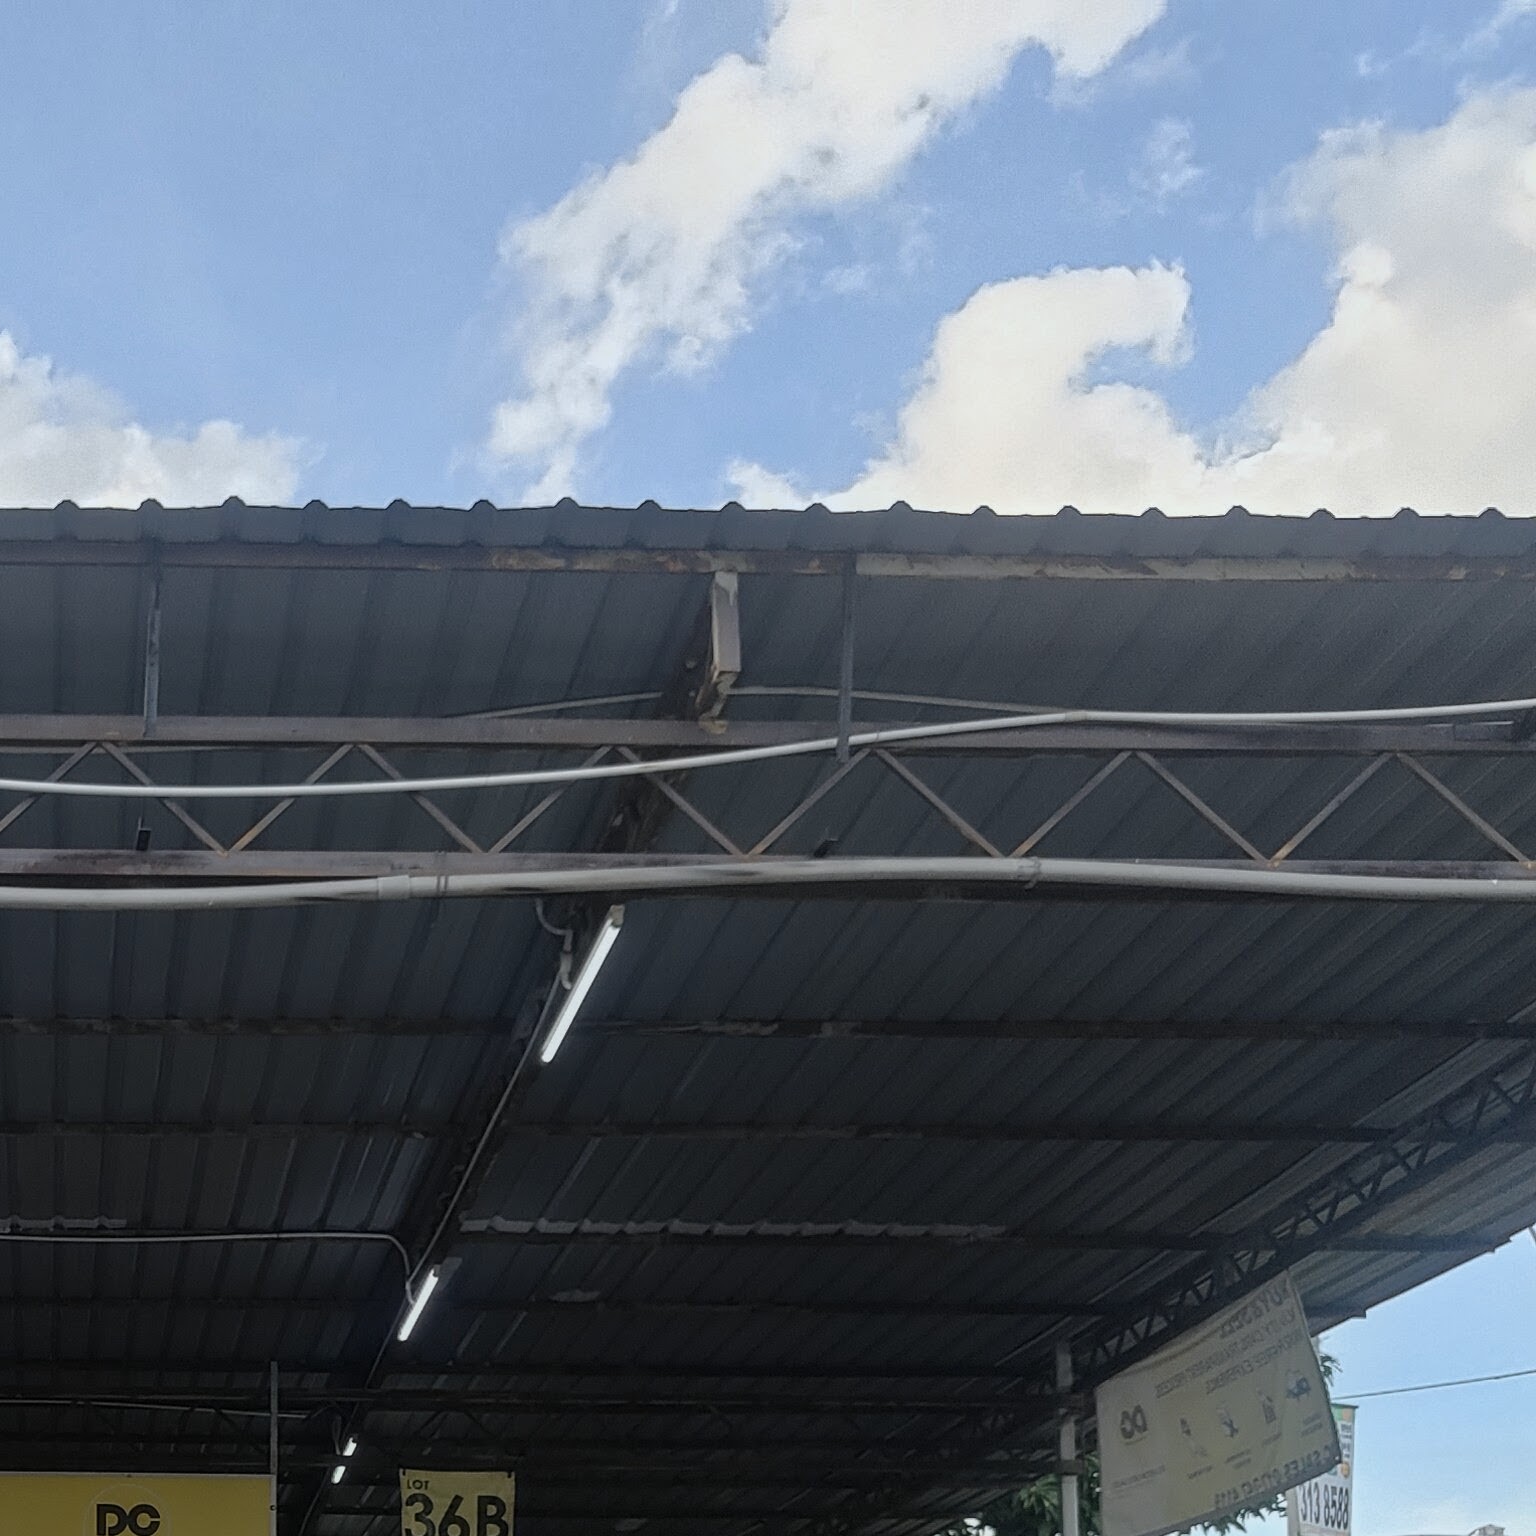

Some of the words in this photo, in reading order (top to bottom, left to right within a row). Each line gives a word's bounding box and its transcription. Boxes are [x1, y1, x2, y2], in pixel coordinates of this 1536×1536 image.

[407, 1479, 430, 1490] LOT
[96, 1503, 161, 1536] DC
[1323, 1484, 1350, 1530] 8588
